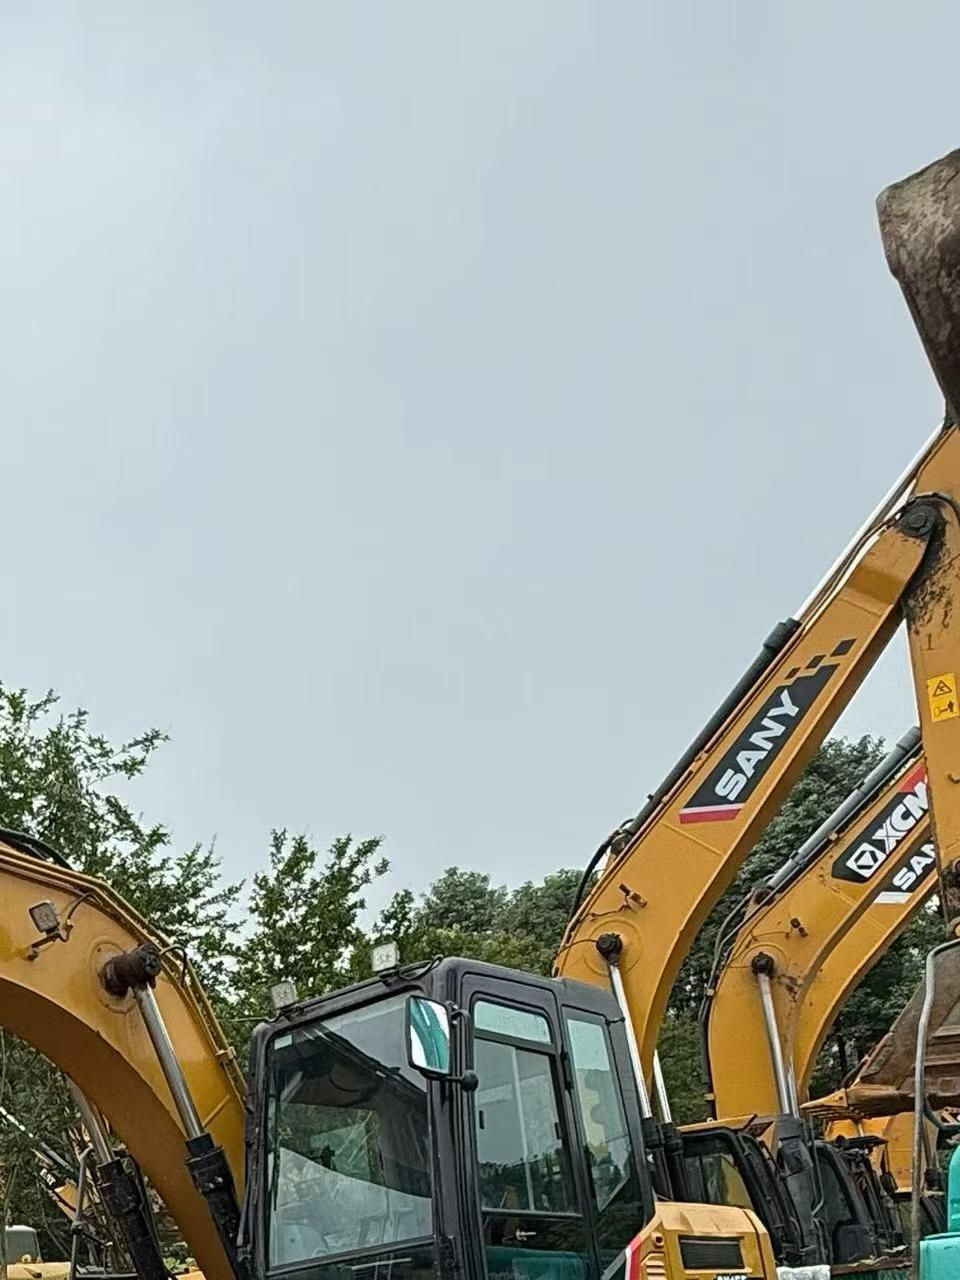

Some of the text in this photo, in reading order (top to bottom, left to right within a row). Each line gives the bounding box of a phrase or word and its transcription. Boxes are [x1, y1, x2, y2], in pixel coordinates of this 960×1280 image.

[714, 688, 800, 802] SANY
[871, 779, 929, 854] XCM
[892, 840, 937, 891] SAN
